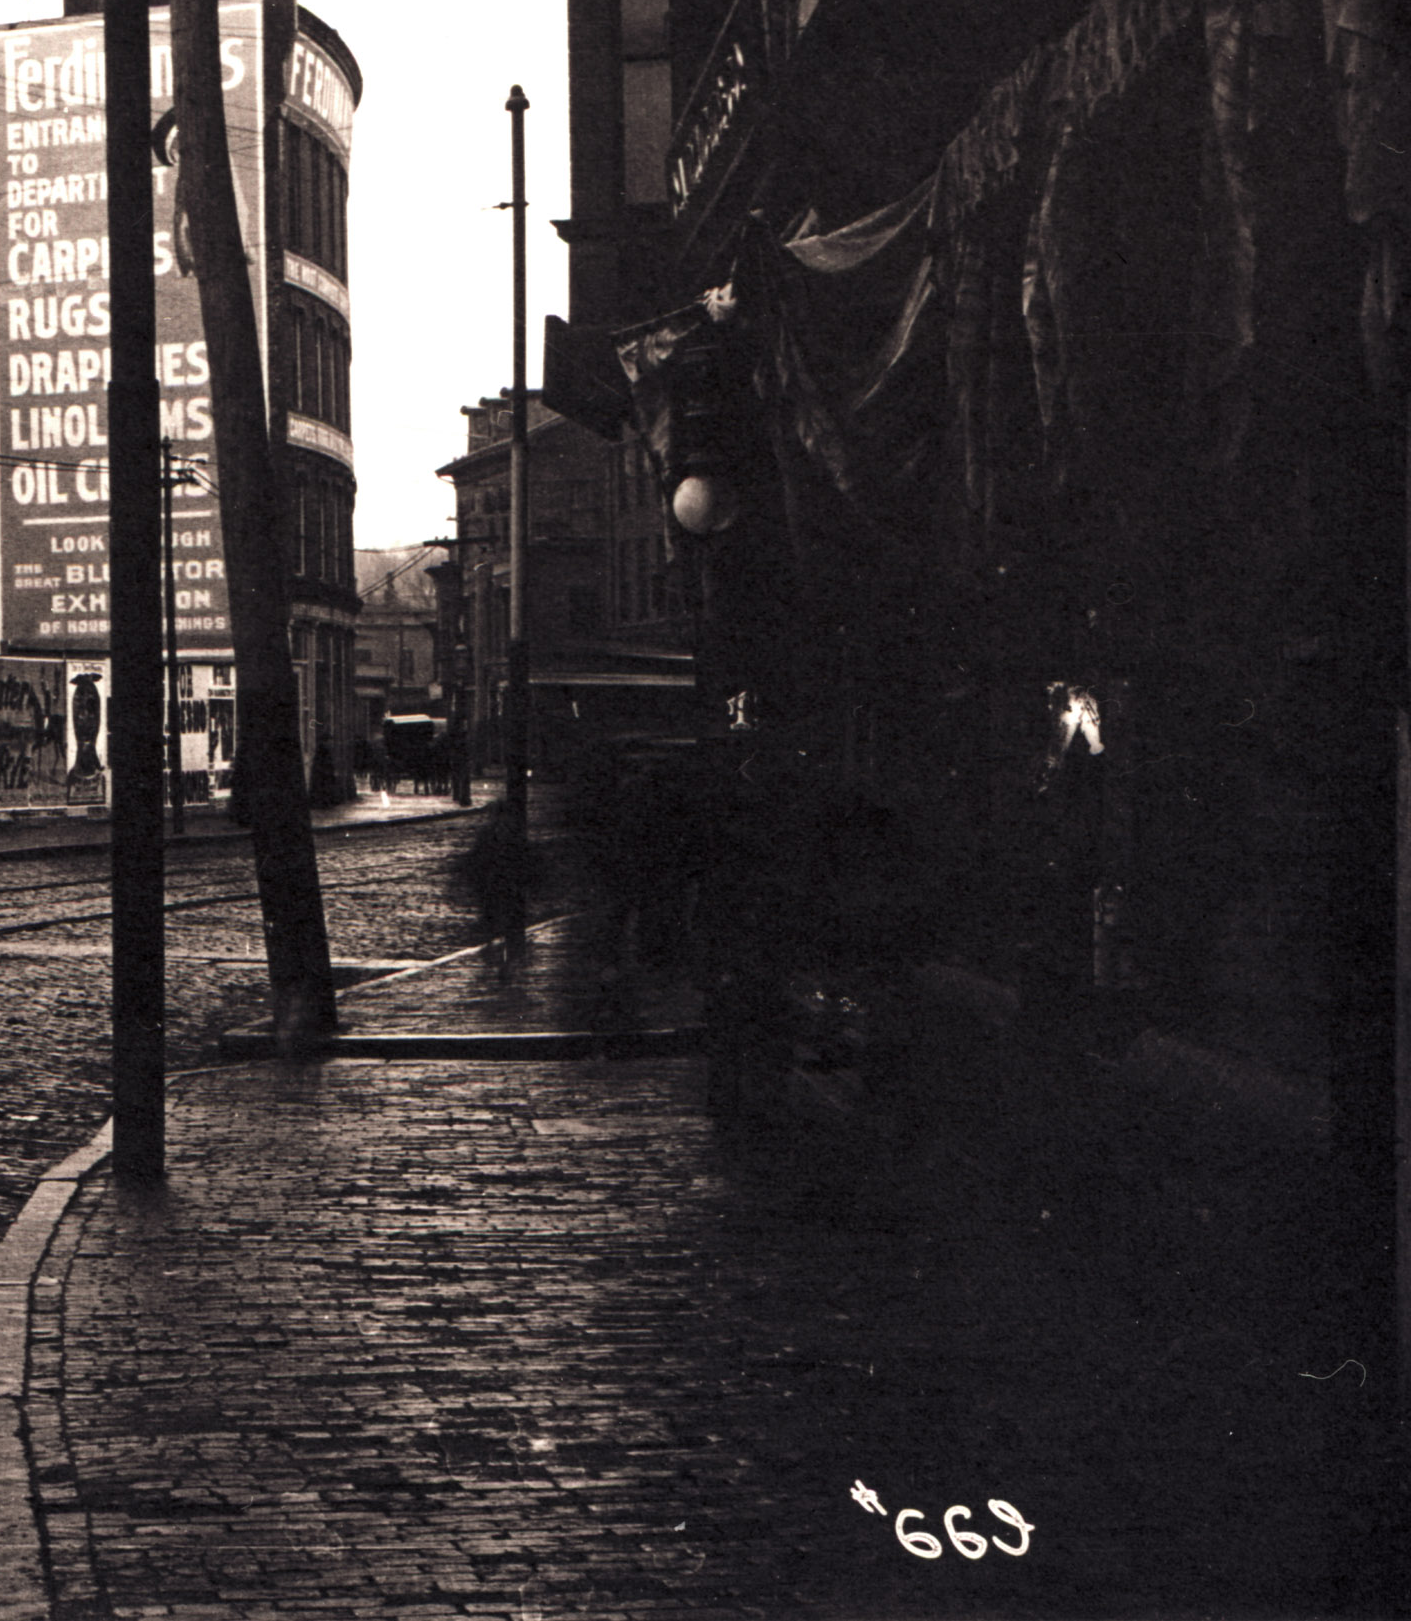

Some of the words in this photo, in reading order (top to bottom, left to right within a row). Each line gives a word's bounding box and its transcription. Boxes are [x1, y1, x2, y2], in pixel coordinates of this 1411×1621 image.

[7, 116, 107, 151] ENTRAN
[7, 153, 39, 176] TO
[7, 166, 171, 209] DEPARTT
[8, 209, 59, 241] FOR
[8, 231, 175, 285] CARPS
[8, 292, 111, 341] RUGS
[11, 397, 214, 451] LINOLMS
[11, 462, 68, 504] OIL
[50, 536, 105, 553] LOOK
[67, 618, 111, 633] HOUS
